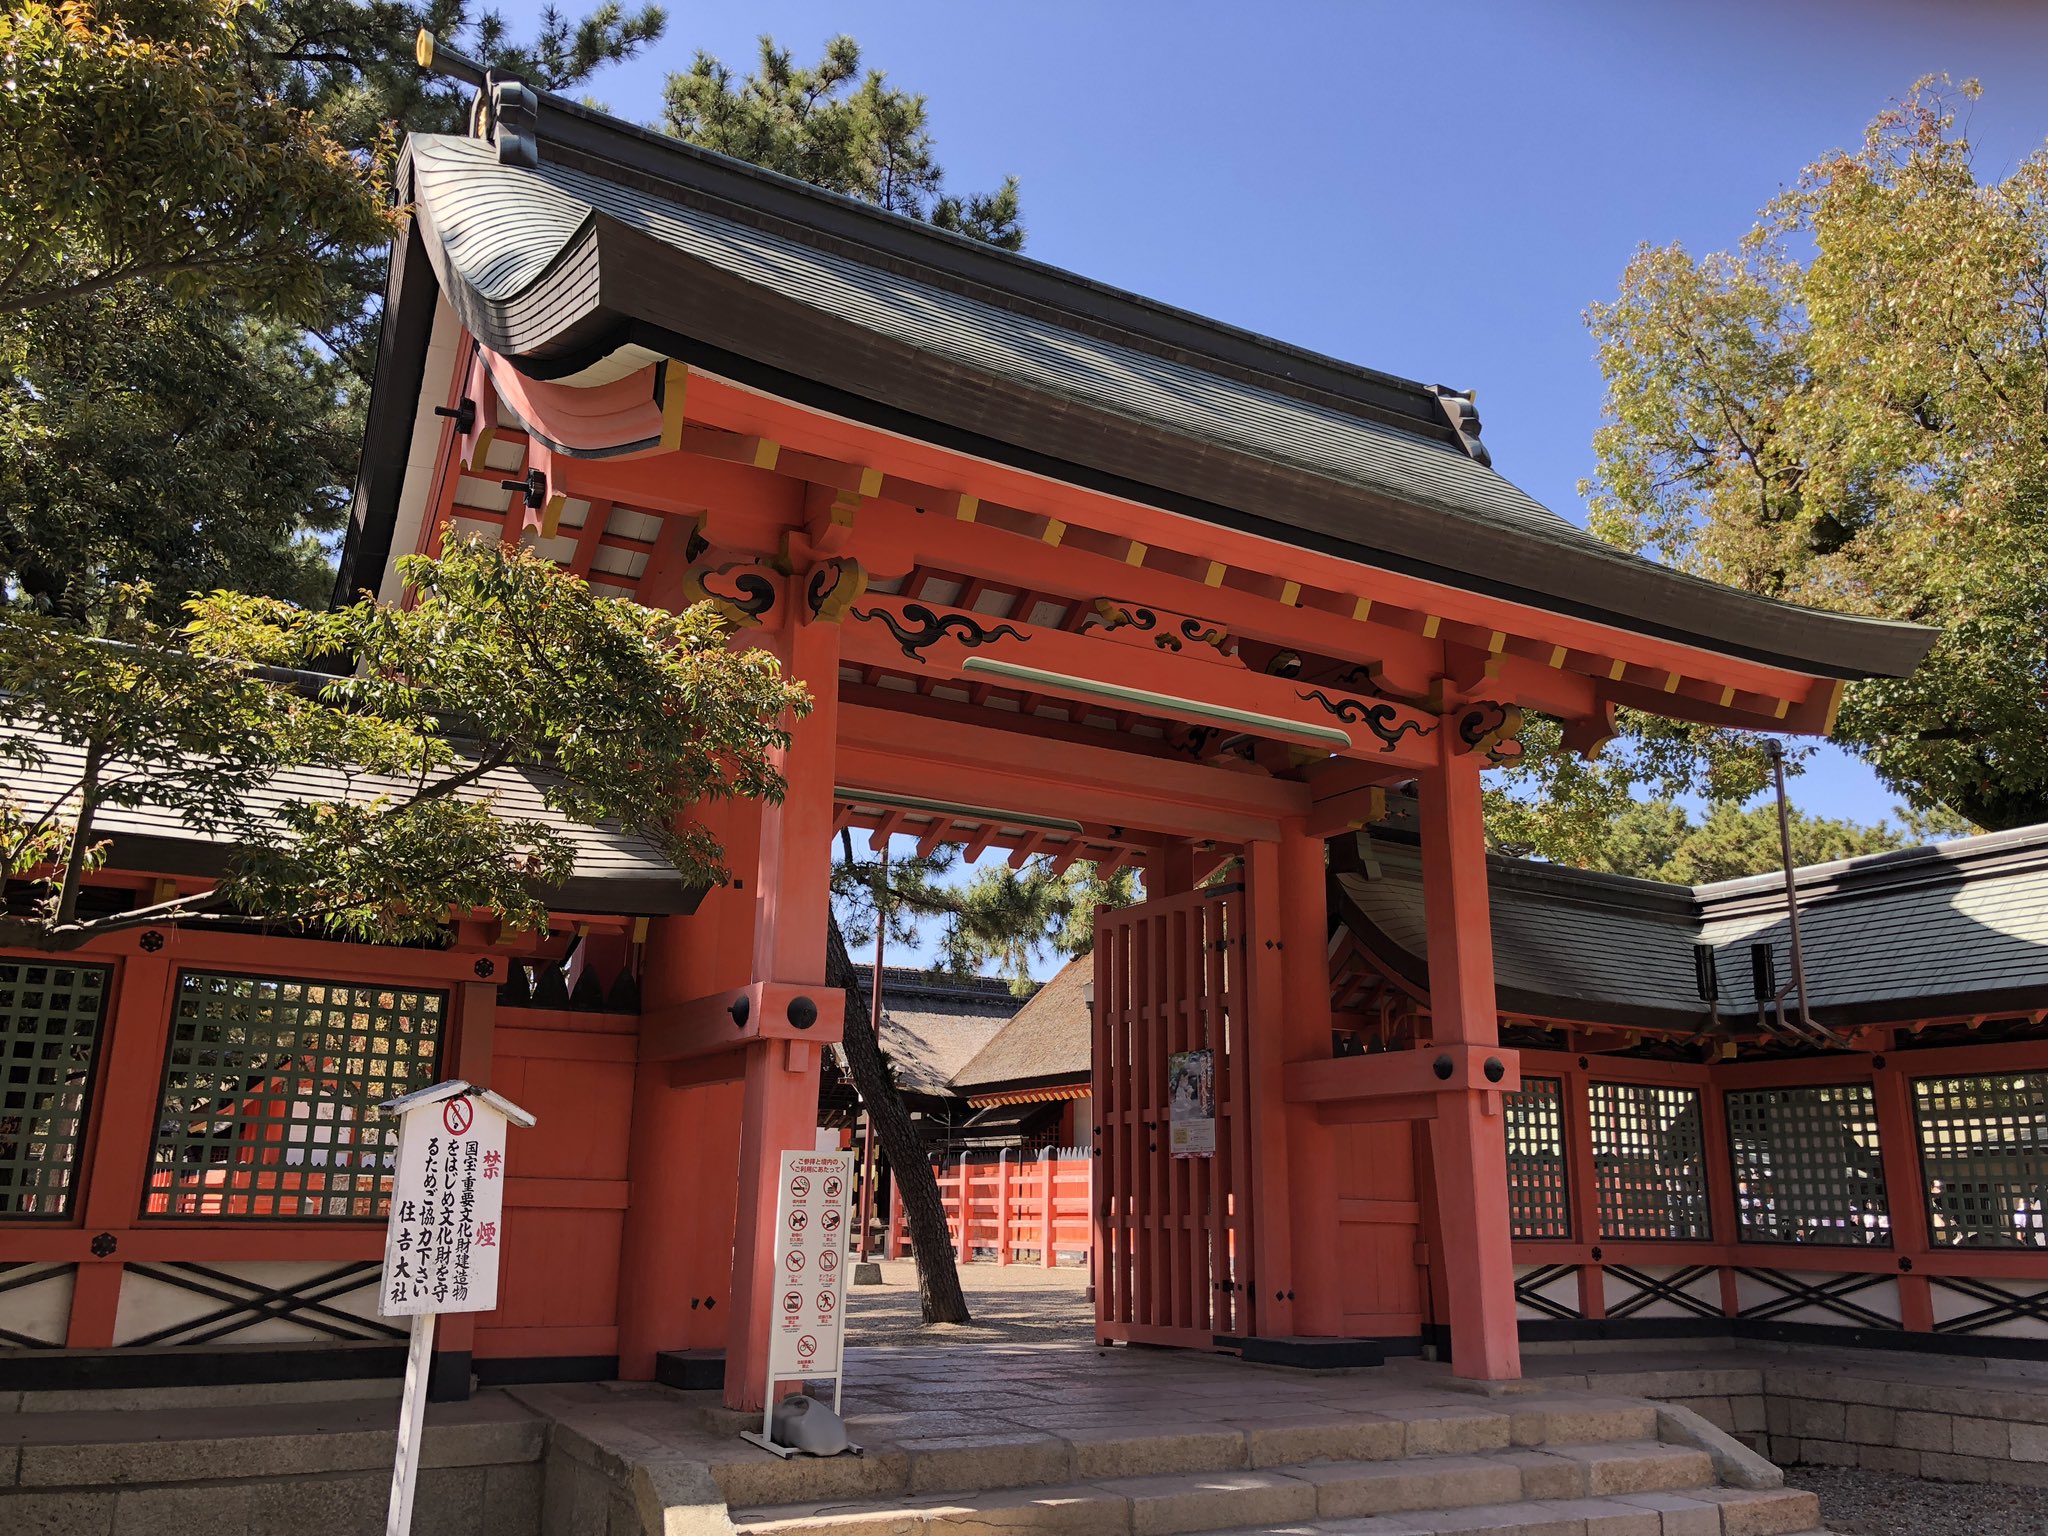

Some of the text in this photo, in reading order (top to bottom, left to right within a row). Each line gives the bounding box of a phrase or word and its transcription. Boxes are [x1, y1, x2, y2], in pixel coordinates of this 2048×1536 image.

[390, 1200, 416, 1304] 住吉大社
[413, 1137, 439, 1298] るためご協力下さい
[431, 1138, 460, 1303] をはじめ文化財を守
[475, 1150, 502, 1247] 禁煙
